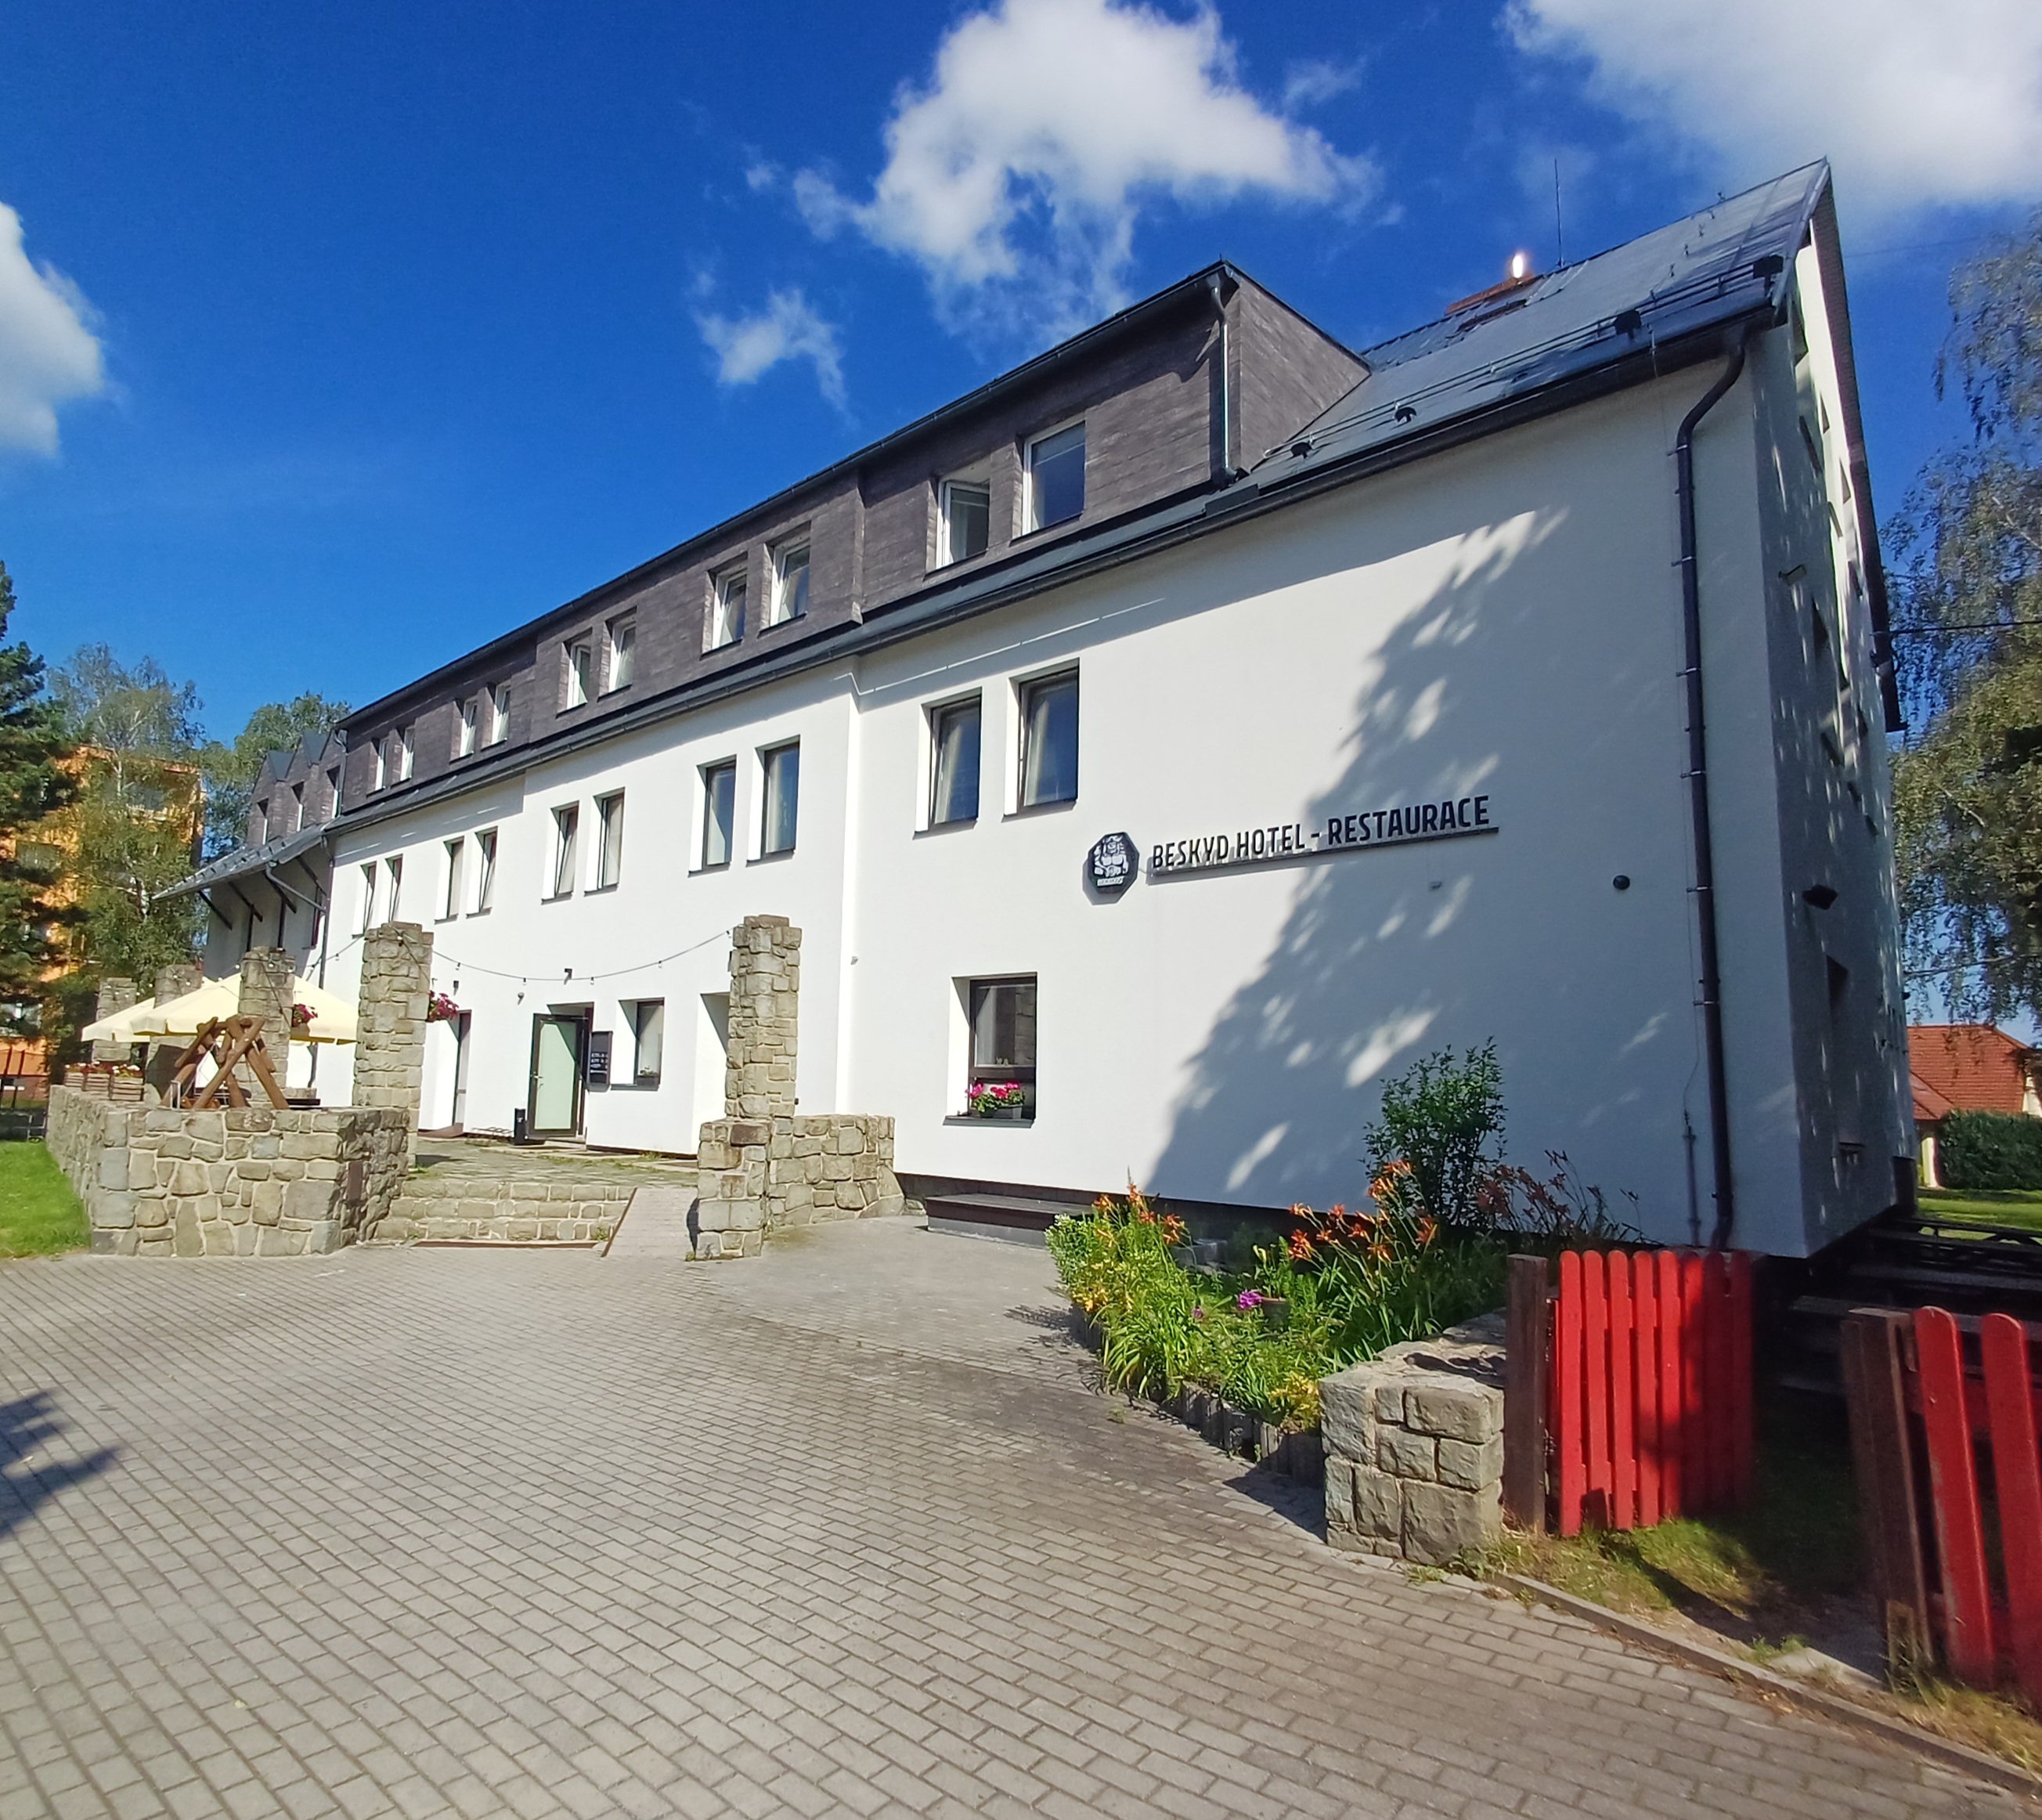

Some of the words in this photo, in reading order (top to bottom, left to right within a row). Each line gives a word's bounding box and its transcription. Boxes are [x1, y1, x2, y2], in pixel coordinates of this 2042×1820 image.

[1153, 835, 1228, 868] BESKYD
[1237, 824, 1305, 858] HOTEL
[1328, 796, 1489, 845] RESTAURACE
